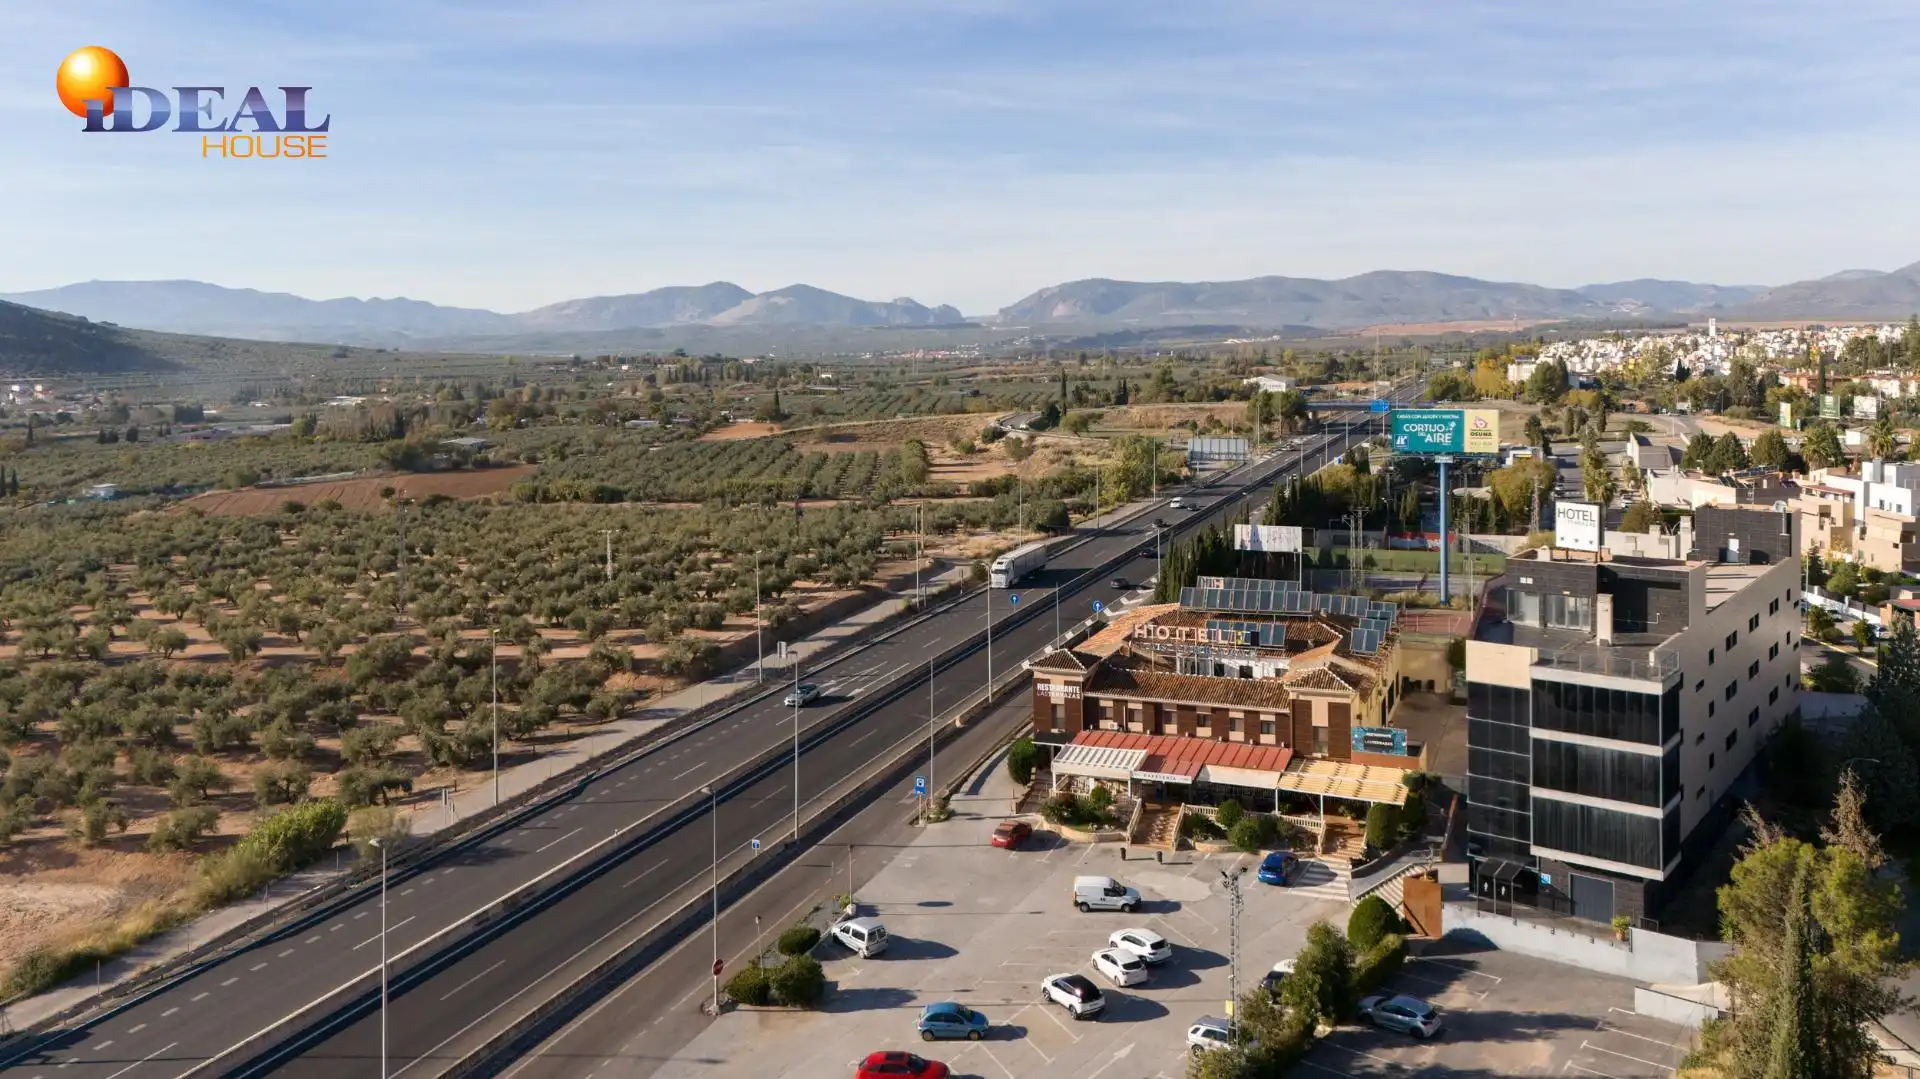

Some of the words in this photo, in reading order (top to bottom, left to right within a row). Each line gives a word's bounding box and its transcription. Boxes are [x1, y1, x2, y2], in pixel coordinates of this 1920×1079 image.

[1403, 423, 1445, 432] CORTIJO
[1424, 433, 1452, 443] AIRE
[1557, 508, 1596, 522] HOTEL
[1134, 624, 1229, 644] HOTEL
[1036, 683, 1080, 694] RESTAURANTE
